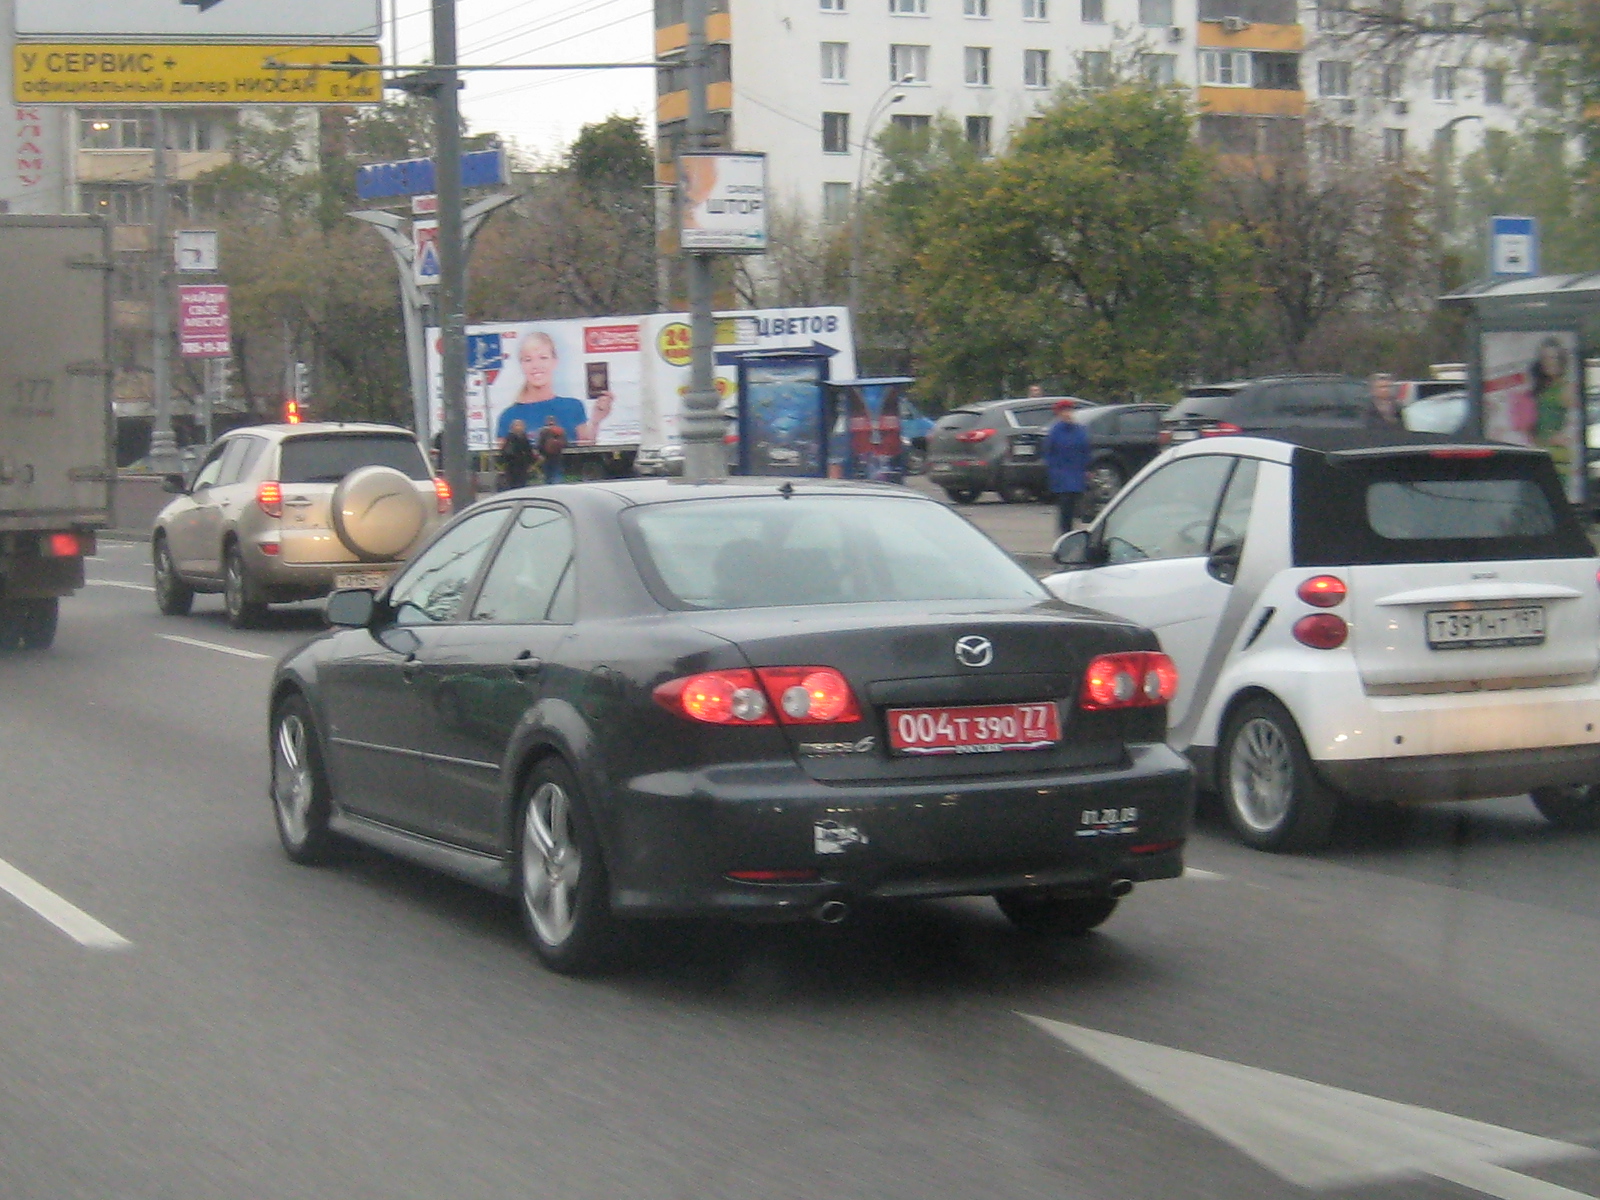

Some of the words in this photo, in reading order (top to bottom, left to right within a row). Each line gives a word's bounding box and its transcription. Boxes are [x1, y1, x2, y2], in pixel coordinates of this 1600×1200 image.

[22, 53, 37, 72] У
[47, 52, 154, 73] СЕРВИС
[170, 80, 230, 95] дилер
[706, 198, 763, 214] ШТОР
[756, 315, 838, 338] ЦВЕТОВ
[973, 716, 1017, 740] 390
[1018, 706, 1048, 729] 77
